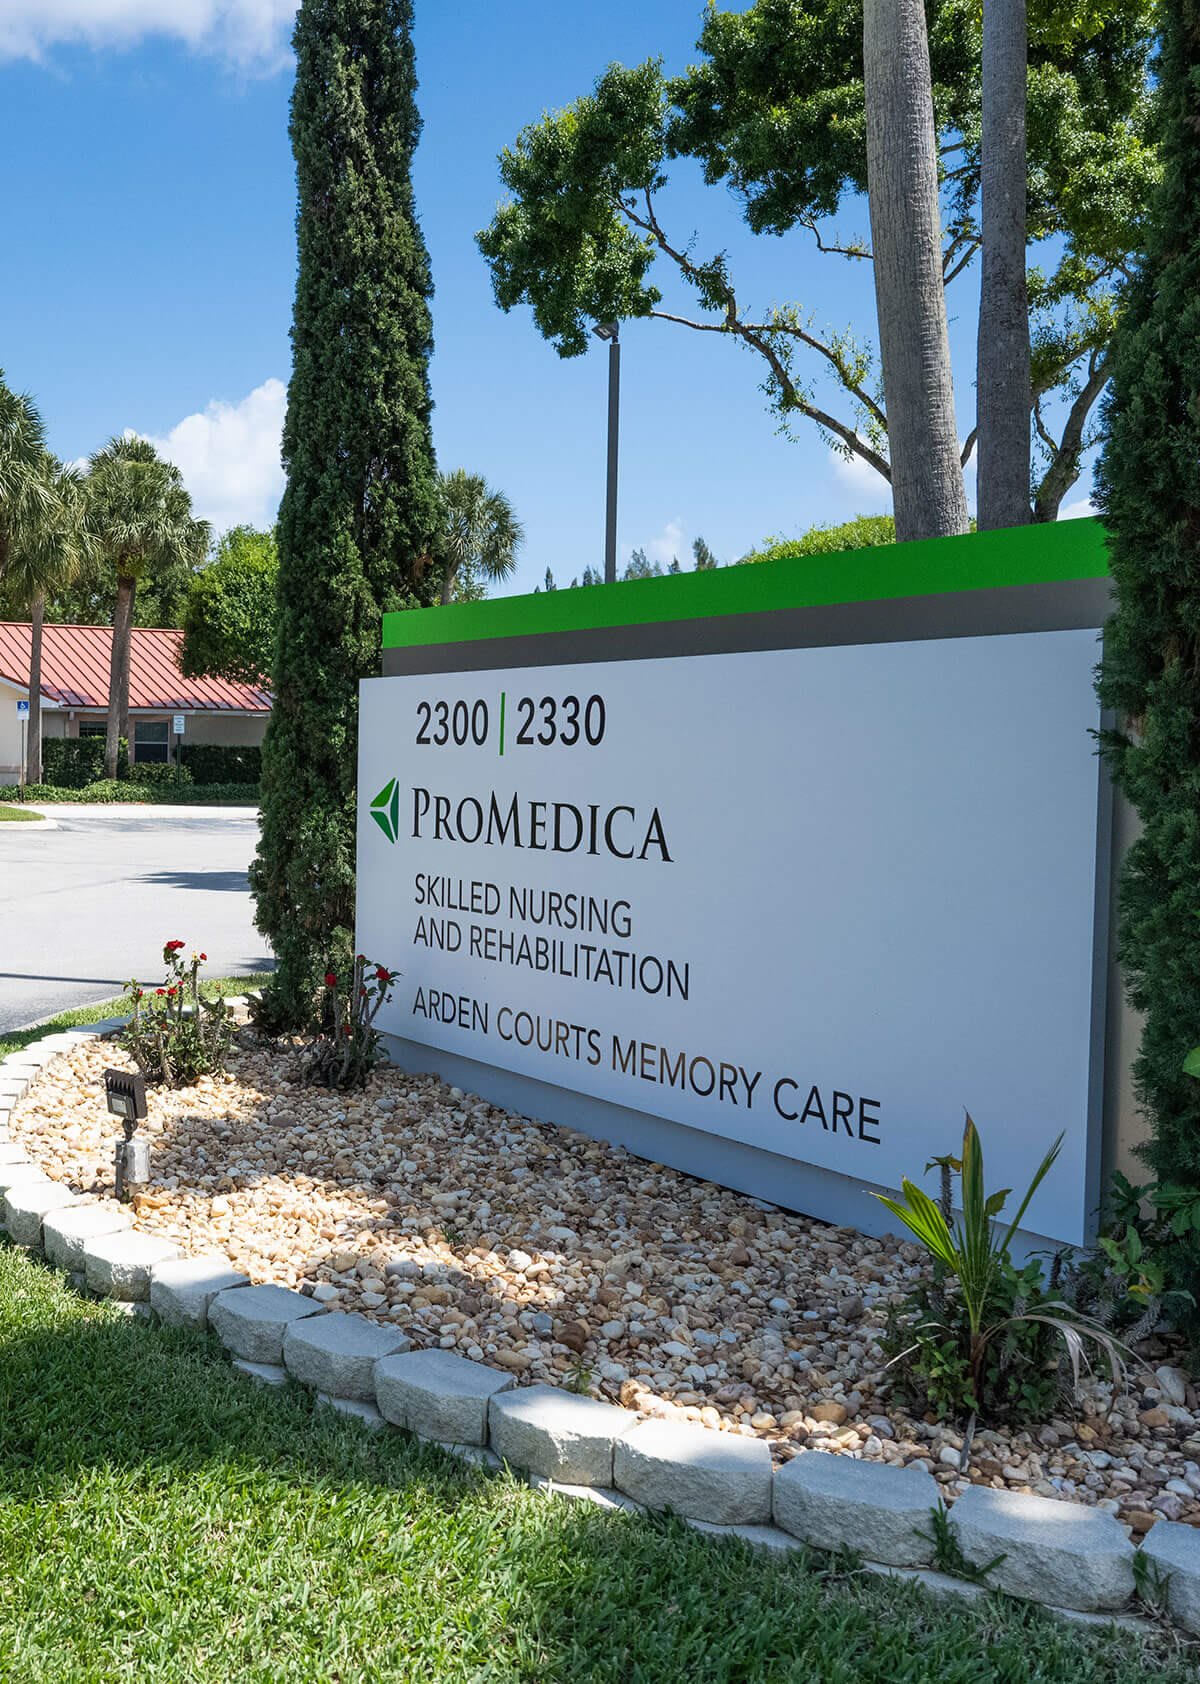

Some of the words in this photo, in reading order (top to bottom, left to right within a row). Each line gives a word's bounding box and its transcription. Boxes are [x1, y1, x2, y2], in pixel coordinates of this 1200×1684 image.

[415, 699, 489, 746] 2300
[516, 694, 606, 746] 2330
[414, 873, 501, 916] SKILLED
[509, 886, 632, 938] NURSING
[413, 915, 462, 952] AND
[469, 924, 690, 1001] REHABILITATION
[412, 986, 489, 1035] ARDEN
[496, 1006, 602, 1066] COURTS
[612, 1034, 763, 1110] MEMORY
[773, 1077, 881, 1145] CARE
